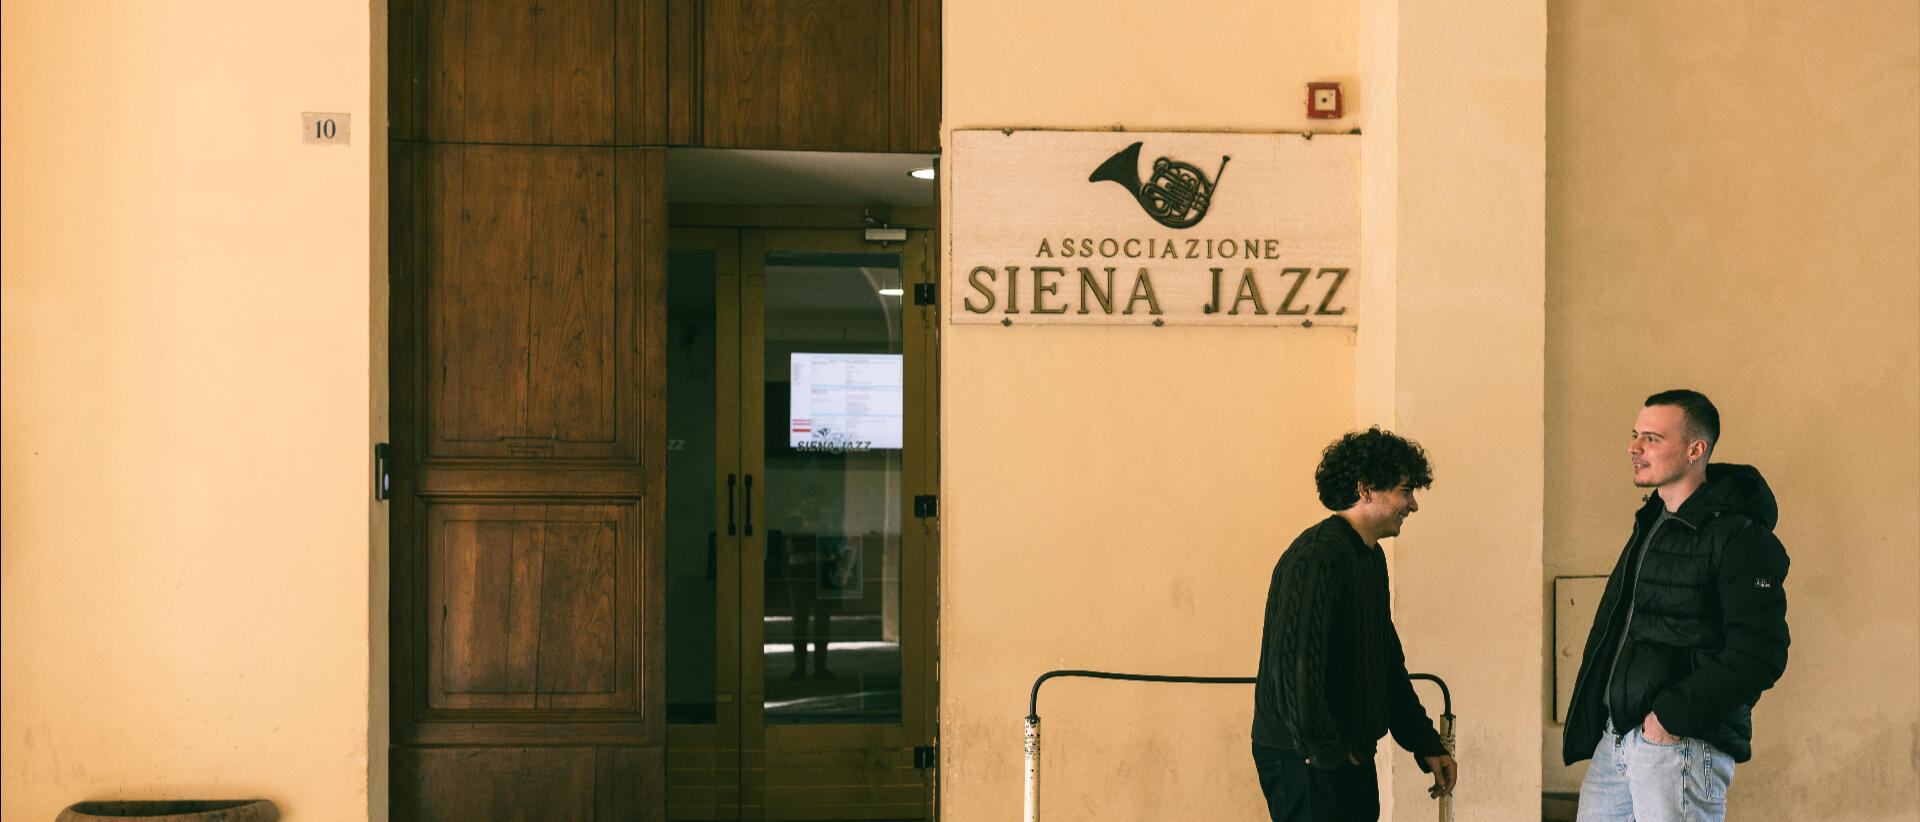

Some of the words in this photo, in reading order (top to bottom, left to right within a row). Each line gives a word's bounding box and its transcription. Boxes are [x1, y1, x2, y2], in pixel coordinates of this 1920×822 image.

[315, 118, 337, 139] 10
[1036, 237, 1281, 259] ASSOCIAZIONE
[964, 265, 1163, 315] SIENA
[1202, 266, 1350, 315] JAZZ
[796, 440, 834, 452] SIENA
[838, 440, 872, 452] JAZZ
